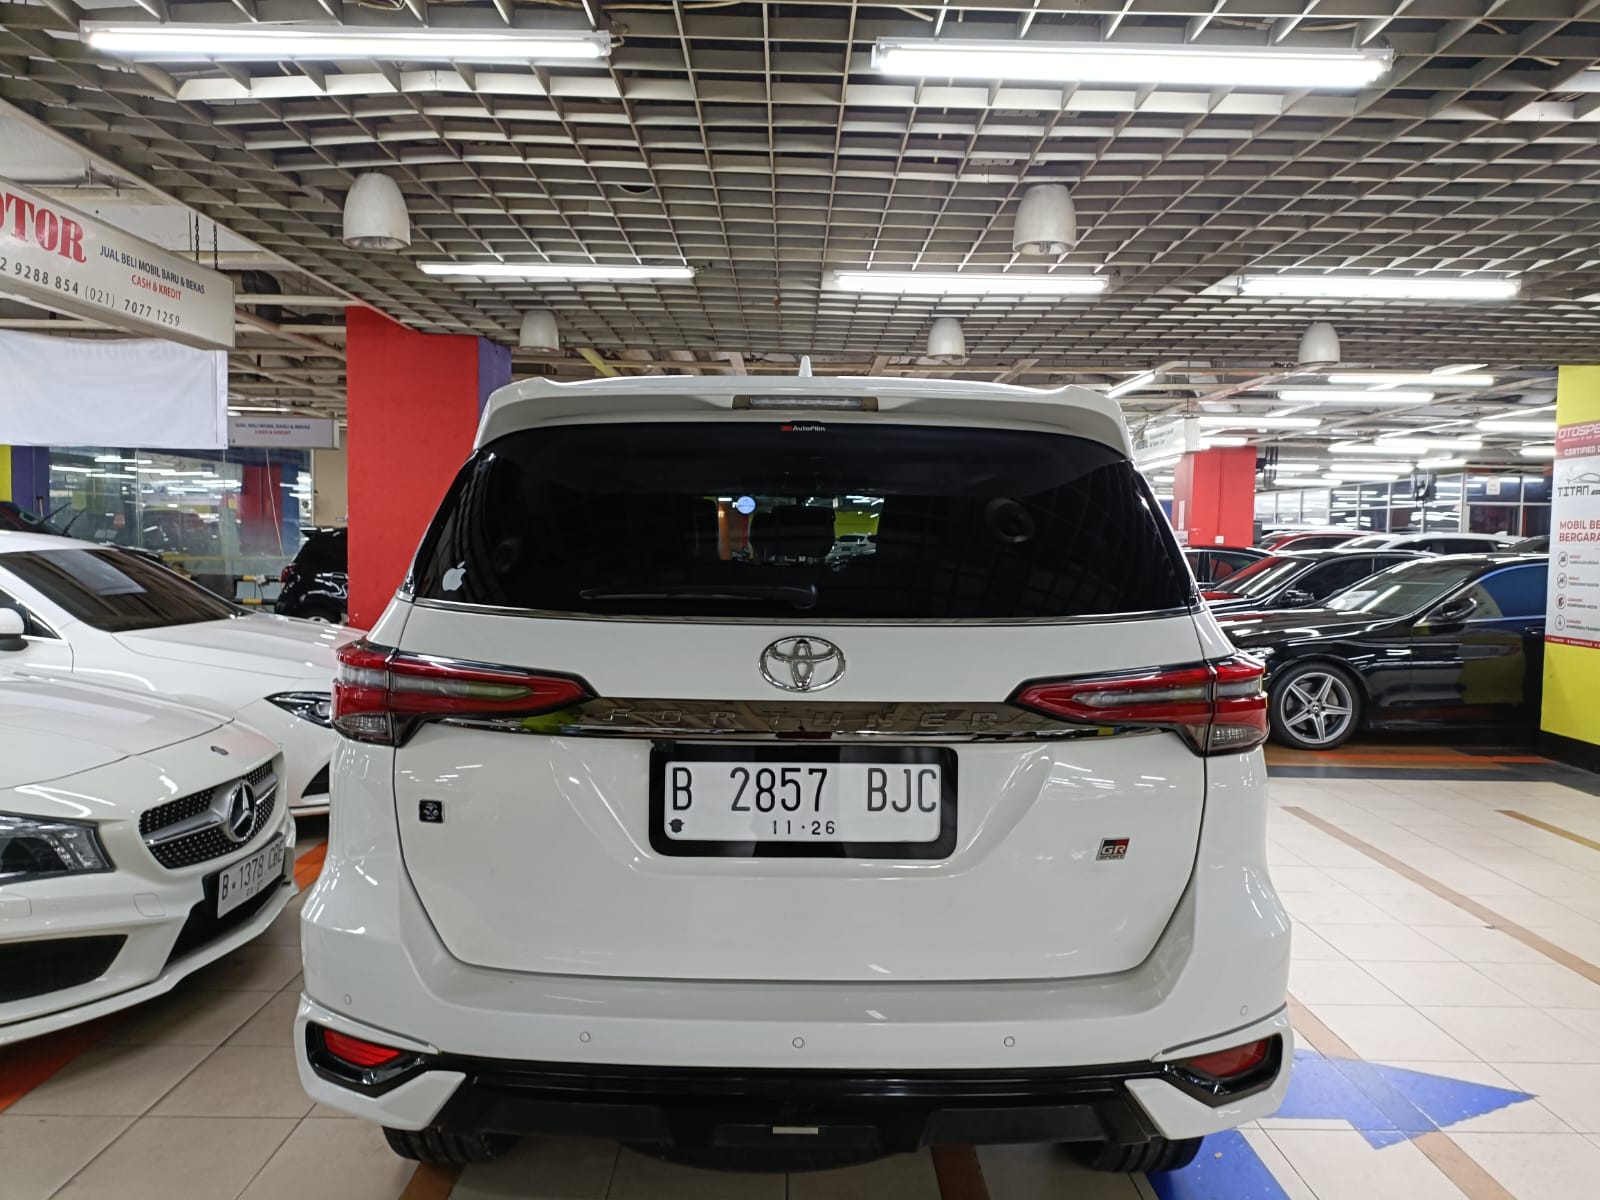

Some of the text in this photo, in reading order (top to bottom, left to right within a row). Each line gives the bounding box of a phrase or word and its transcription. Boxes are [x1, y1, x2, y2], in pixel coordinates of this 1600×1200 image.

[0, 191, 87, 263] TOR
[100, 245, 205, 295] JUAL BELI MOBIL BARU & BEKAS
[131, 274, 181, 300] CASH & KREDIT
[15, 262, 49, 285] 9288
[55, 276, 79, 295] 854
[85, 285, 115, 307] (021)
[124, 299, 152, 318] 7077
[157, 309, 180, 327] 1259
[1557, 485, 1590, 497] TITAN
[1559, 520, 1587, 530] MOBIL
[603, 708, 1000, 728] FORTUNER
[672, 767, 937, 812] B 2857 BJC
[1102, 845, 1127, 854] GR
[222, 874, 229, 900] B
[240, 854, 265, 889] 1378
